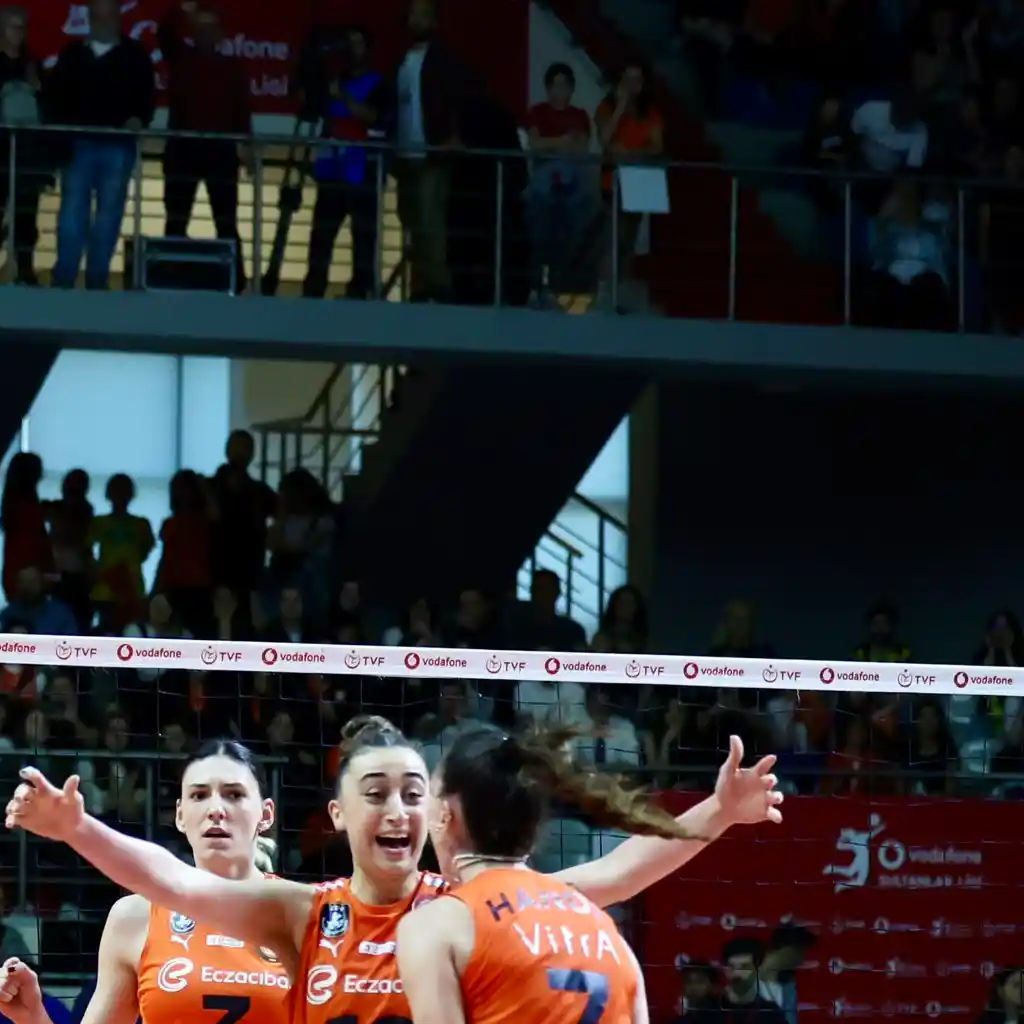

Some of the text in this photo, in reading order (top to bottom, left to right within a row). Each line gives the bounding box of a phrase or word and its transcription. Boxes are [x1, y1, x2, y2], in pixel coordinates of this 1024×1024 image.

[73, 646, 98, 659] TVF
[135, 647, 182, 659] vodafone
[218, 651, 243, 663] TVF
[279, 651, 326, 663] vodafone
[362, 655, 386, 667] TVF
[421, 656, 468, 668] vodafone
[503, 661, 527, 673] TVF
[562, 660, 607, 672] vodafone
[642, 665, 665, 677] TVF
[700, 666, 745, 677] vodafone
[779, 670, 802, 682] TVF
[836, 670, 880, 682] vodafone
[914, 674, 937, 686] TVF
[970, 675, 1013, 686] vodafone
[201, 966, 293, 990] Eczacıba
[343, 974, 405, 994] Eczac
